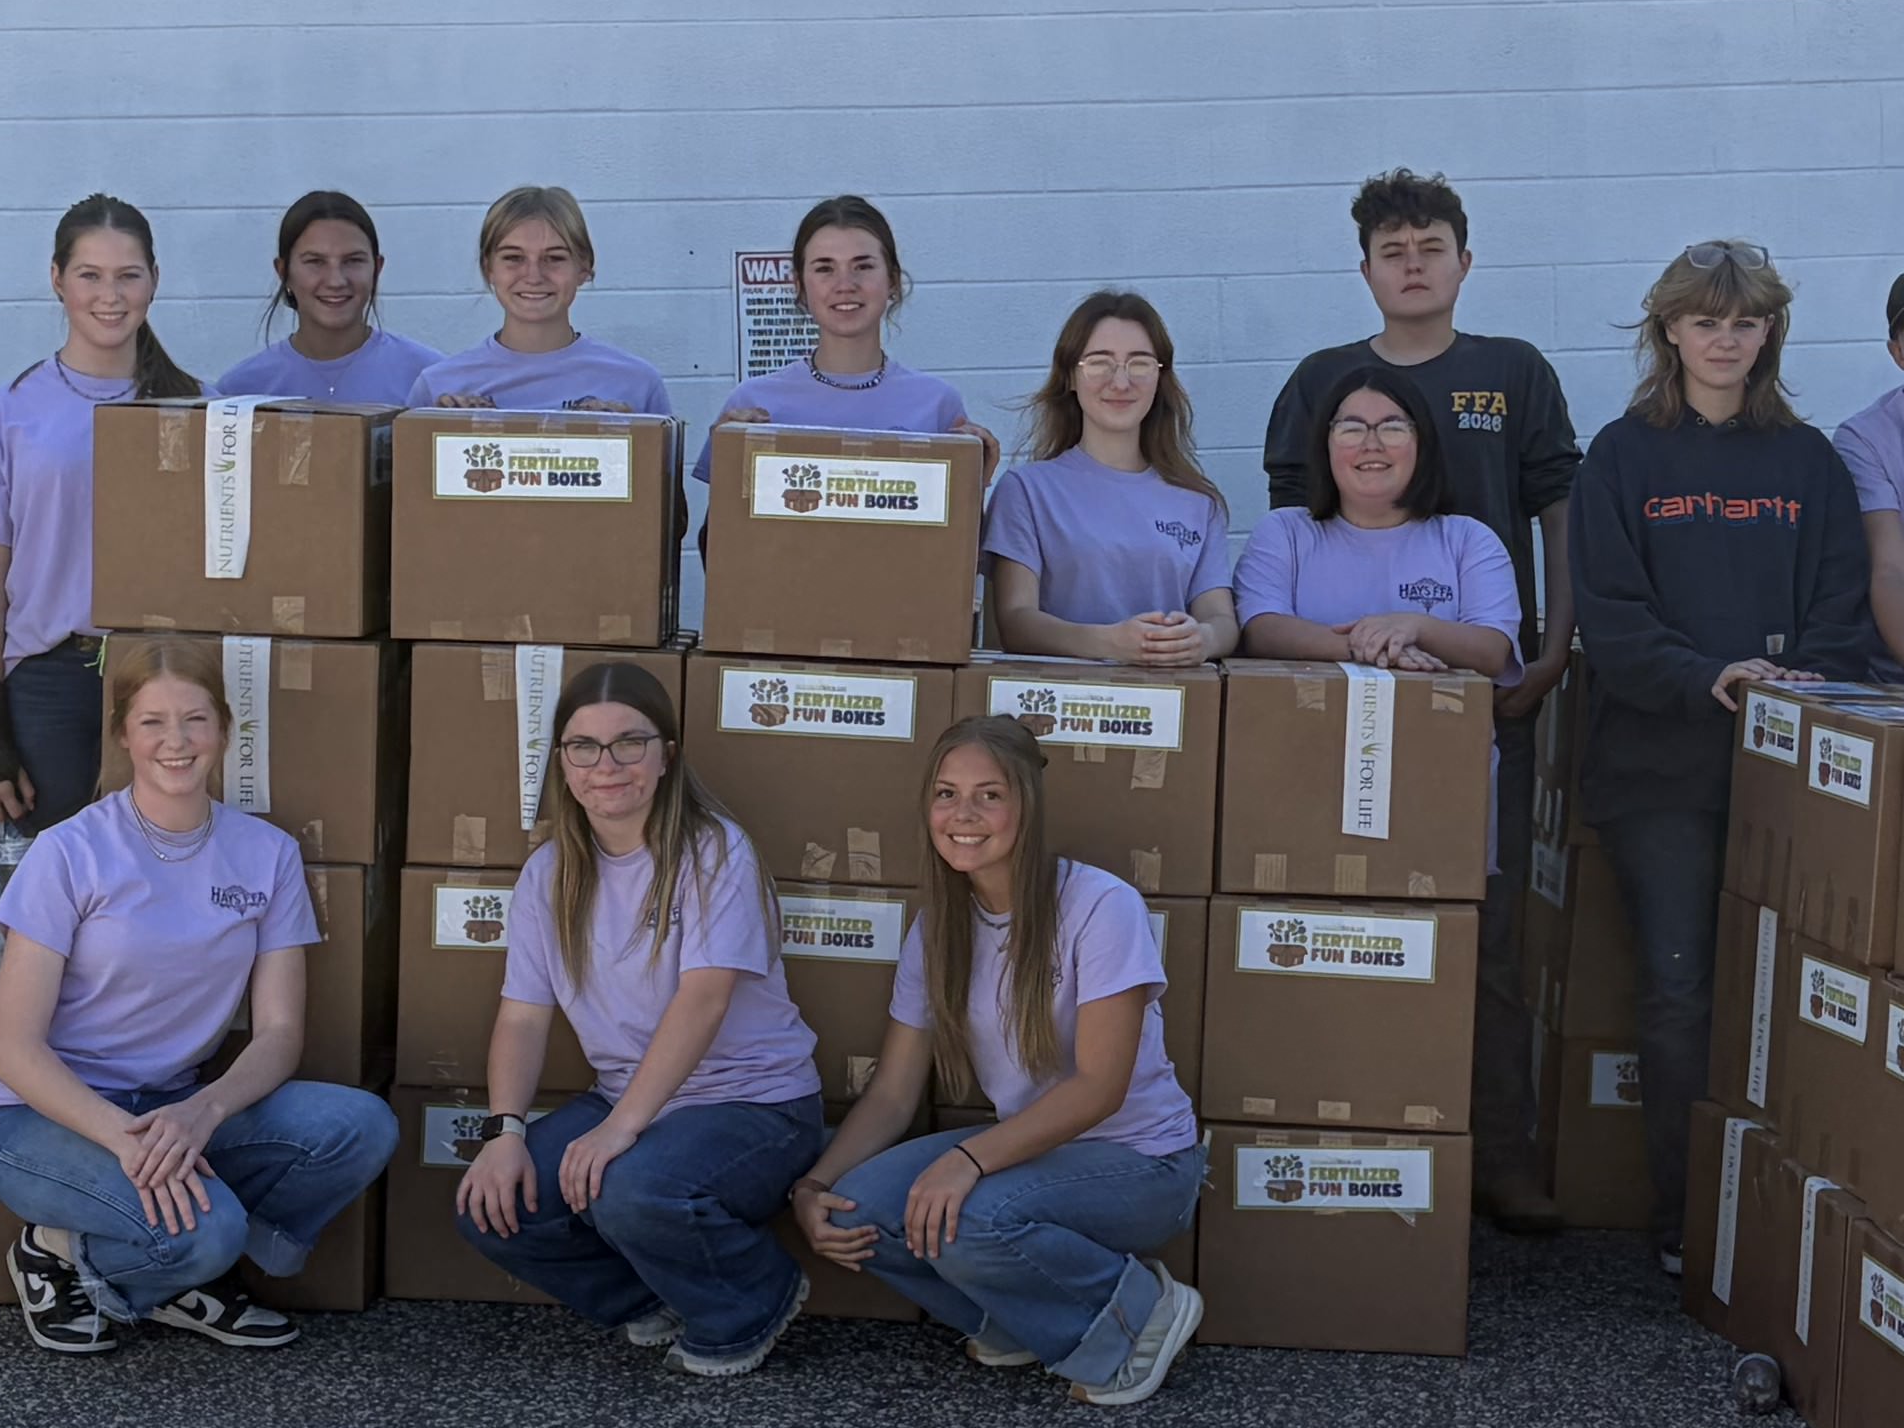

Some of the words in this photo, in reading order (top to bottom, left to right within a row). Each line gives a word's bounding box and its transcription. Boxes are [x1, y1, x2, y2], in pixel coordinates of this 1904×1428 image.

[223, 404, 239, 417] LI
[1450, 391, 1508, 416] FFA
[1458, 413, 1503, 433] 2026
[222, 423, 237, 456] FOR
[507, 456, 599, 471] FERTILIZER
[507, 472, 542, 486] FUN
[547, 472, 602, 487] BOXES
[826, 477, 917, 494] FERTILIZER
[825, 493, 859, 508] FUN
[864, 495, 919, 510] BOXES
[1644, 492, 1802, 524] carhartt
[218, 475, 237, 573] NUTRIENTS
[1399, 582, 1432, 600] HAYS
[239, 637, 254, 718] UTRIENTS
[793, 692, 883, 710] FERTILIZER
[793, 707, 826, 723] FUN
[831, 711, 886, 726] BOXES
[1061, 702, 1151, 720] FERTILIZER
[1360, 682, 1377, 741] RIENTS
[1060, 718, 1094, 733] FUN
[1099, 720, 1153, 736] BOXES
[239, 735, 254, 769] FOR
[524, 754, 540, 786] FOR
[1359, 759, 1376, 791] FOR
[239, 775, 254, 807] LIFE
[1357, 797, 1374, 829] LIFE
[211, 885, 241, 906] HAYS
[784, 915, 872, 933] FERTILIZER
[783, 930, 815, 945] FUN
[821, 933, 875, 948] BOXES
[1311, 933, 1403, 951] FERTILIZER
[1311, 949, 1345, 964] FUN
[1350, 950, 1405, 967] BOXES
[1309, 1167, 1400, 1182] FERTILIZER
[1309, 1182, 1343, 1197] FUN
[1348, 1183, 1403, 1198] BOXES
